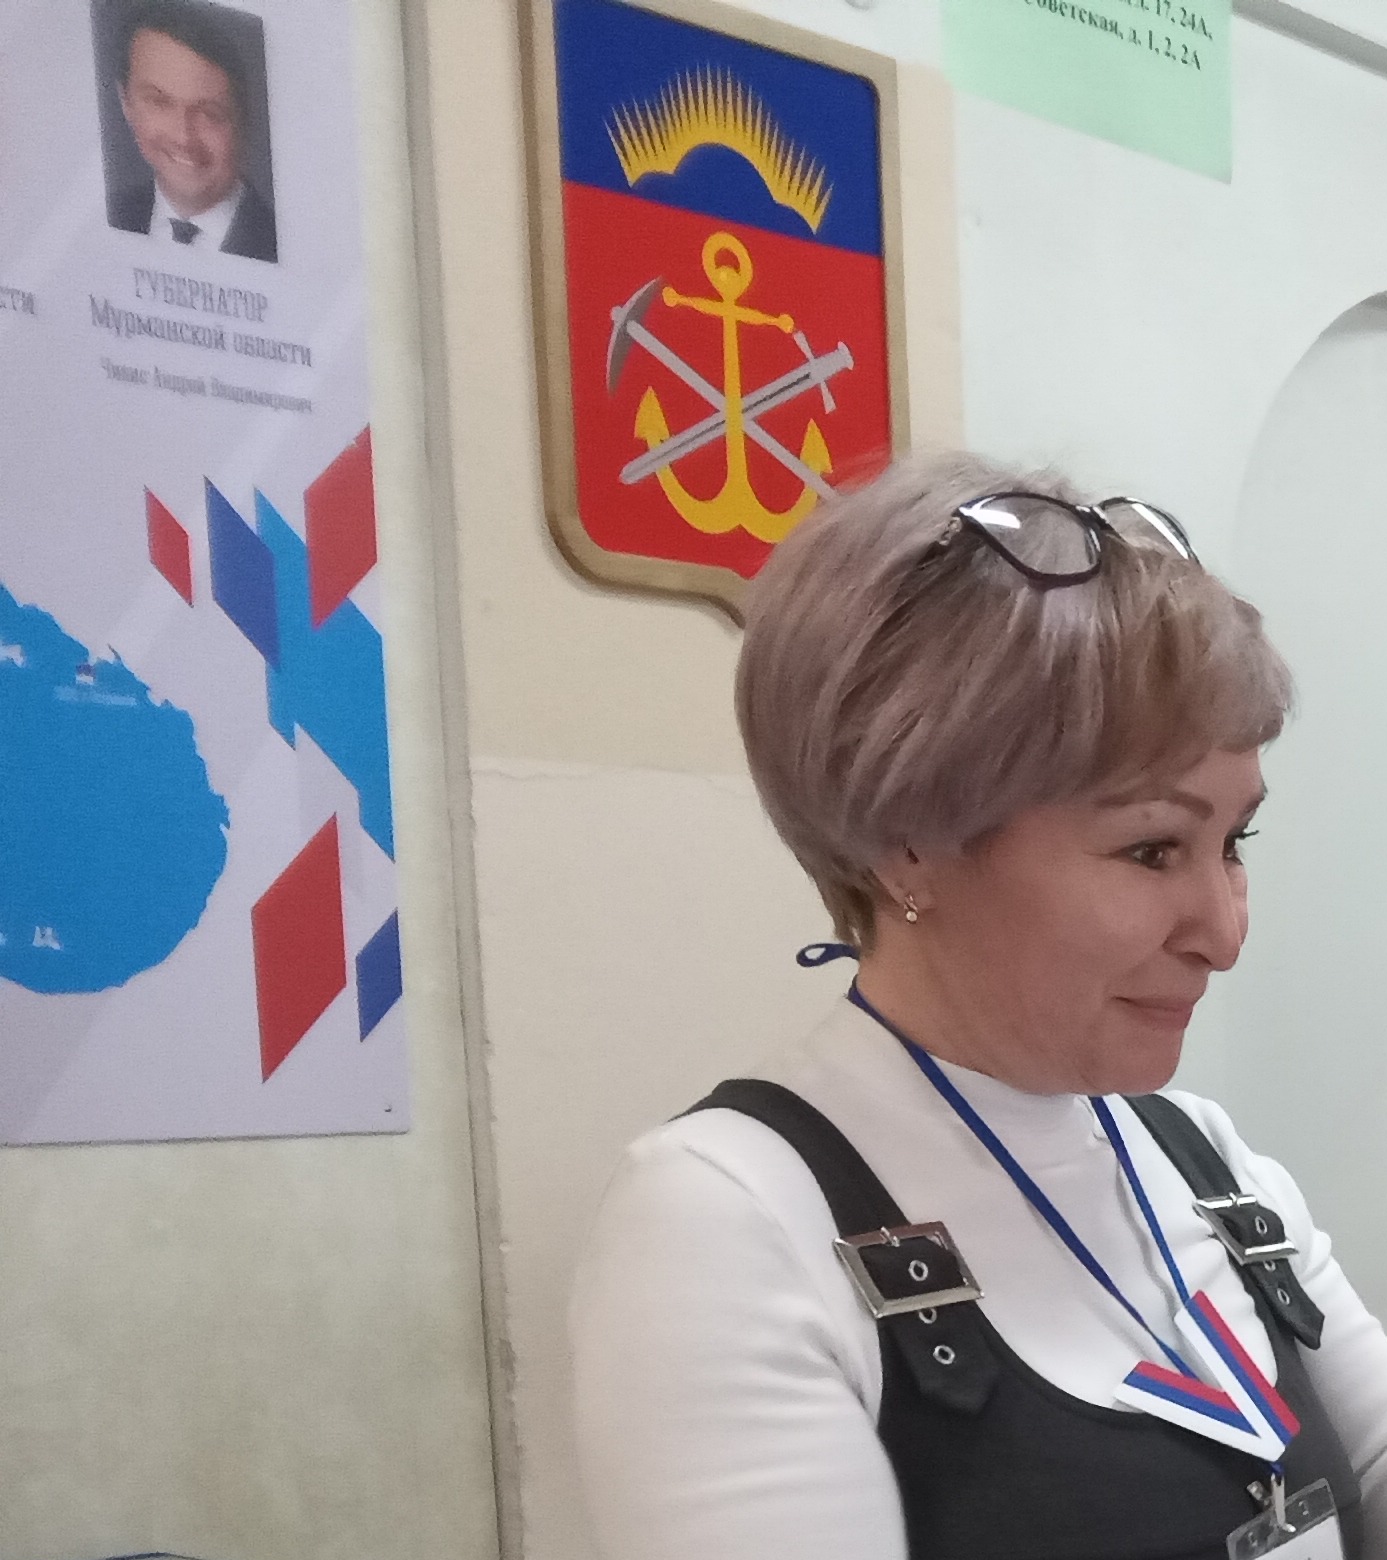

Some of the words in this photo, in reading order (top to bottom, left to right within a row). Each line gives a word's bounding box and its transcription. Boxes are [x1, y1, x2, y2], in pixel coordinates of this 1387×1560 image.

[1024, 0, 1124, 40] оветская,
[133, 267, 268, 323] ГУБЕРНАТОР
[88, 293, 226, 351] Мурманской
[232, 330, 312, 367] области
